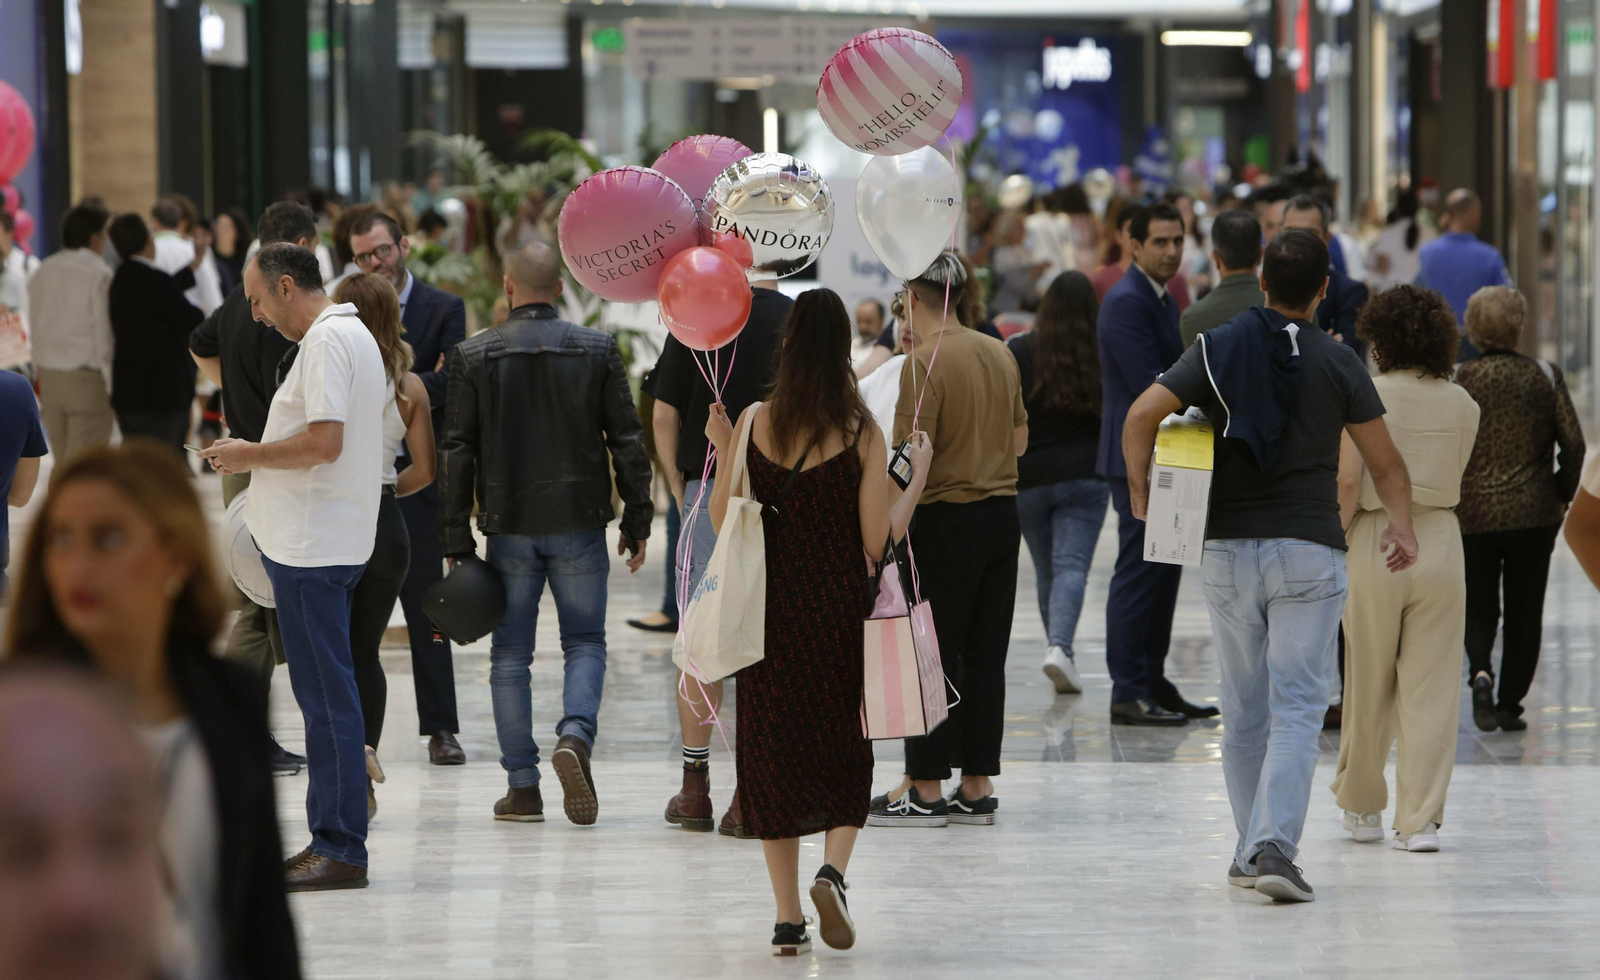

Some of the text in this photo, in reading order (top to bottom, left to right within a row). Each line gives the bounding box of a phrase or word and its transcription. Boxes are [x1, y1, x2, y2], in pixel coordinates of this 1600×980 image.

[571, 220, 676, 269] VICTORIA'S
[715, 216, 821, 250] PANDORA
[597, 246, 665, 283] SECRET
